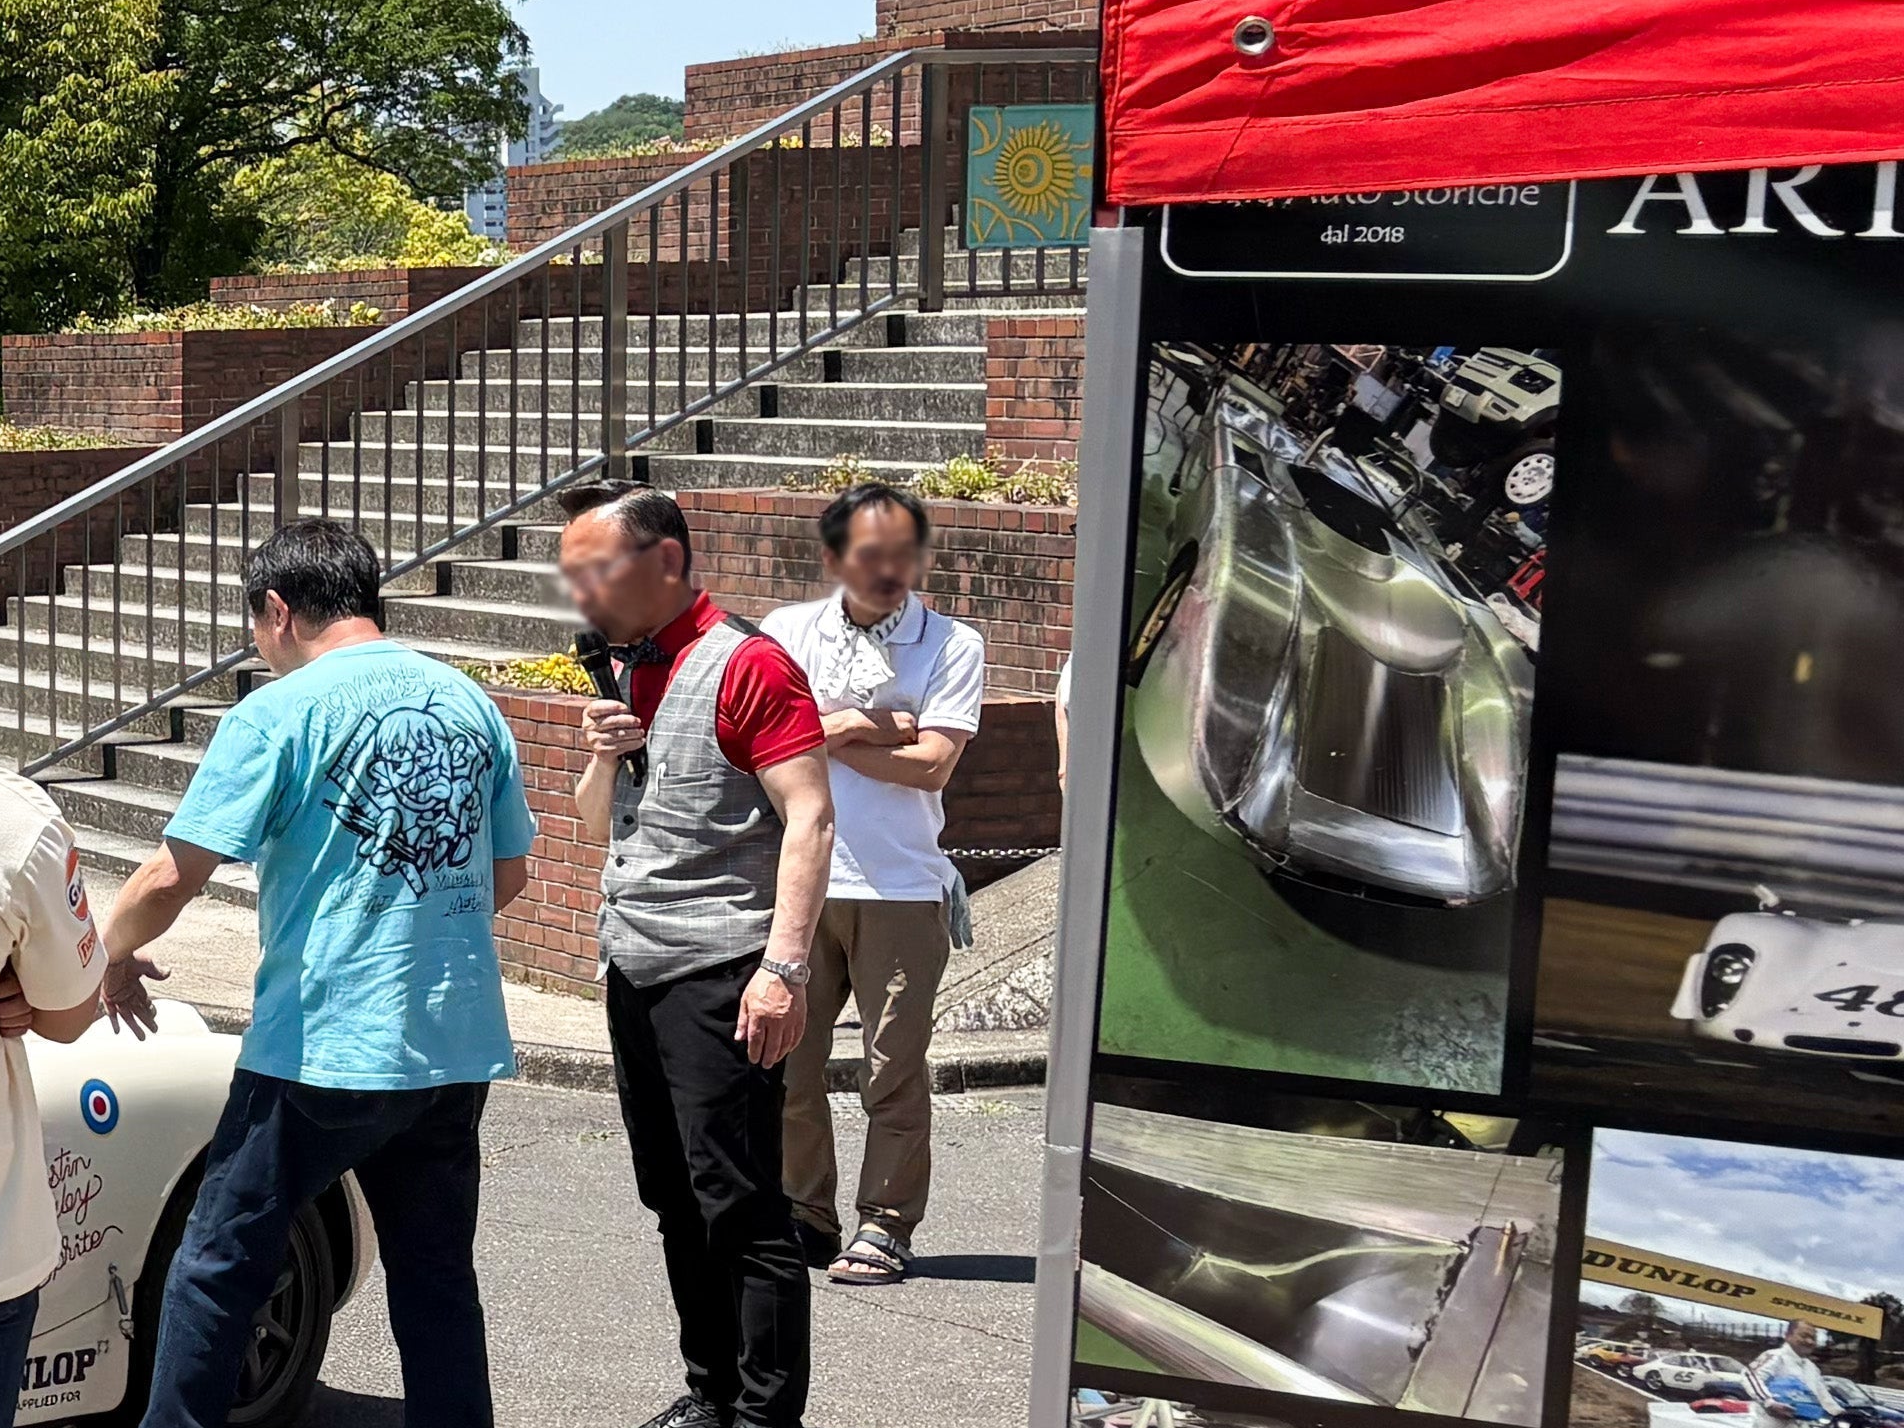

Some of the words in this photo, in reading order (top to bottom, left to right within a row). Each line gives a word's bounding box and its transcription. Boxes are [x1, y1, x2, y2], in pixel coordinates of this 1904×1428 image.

[1320, 225, 1349, 244] dal
[1353, 225, 1405, 244] 2018
[48, 1147, 92, 1189] stin
[55, 1174, 103, 1226] ley
[1582, 1249, 1757, 1298] DUNLOP
[59, 1390, 81, 1404] FOR
